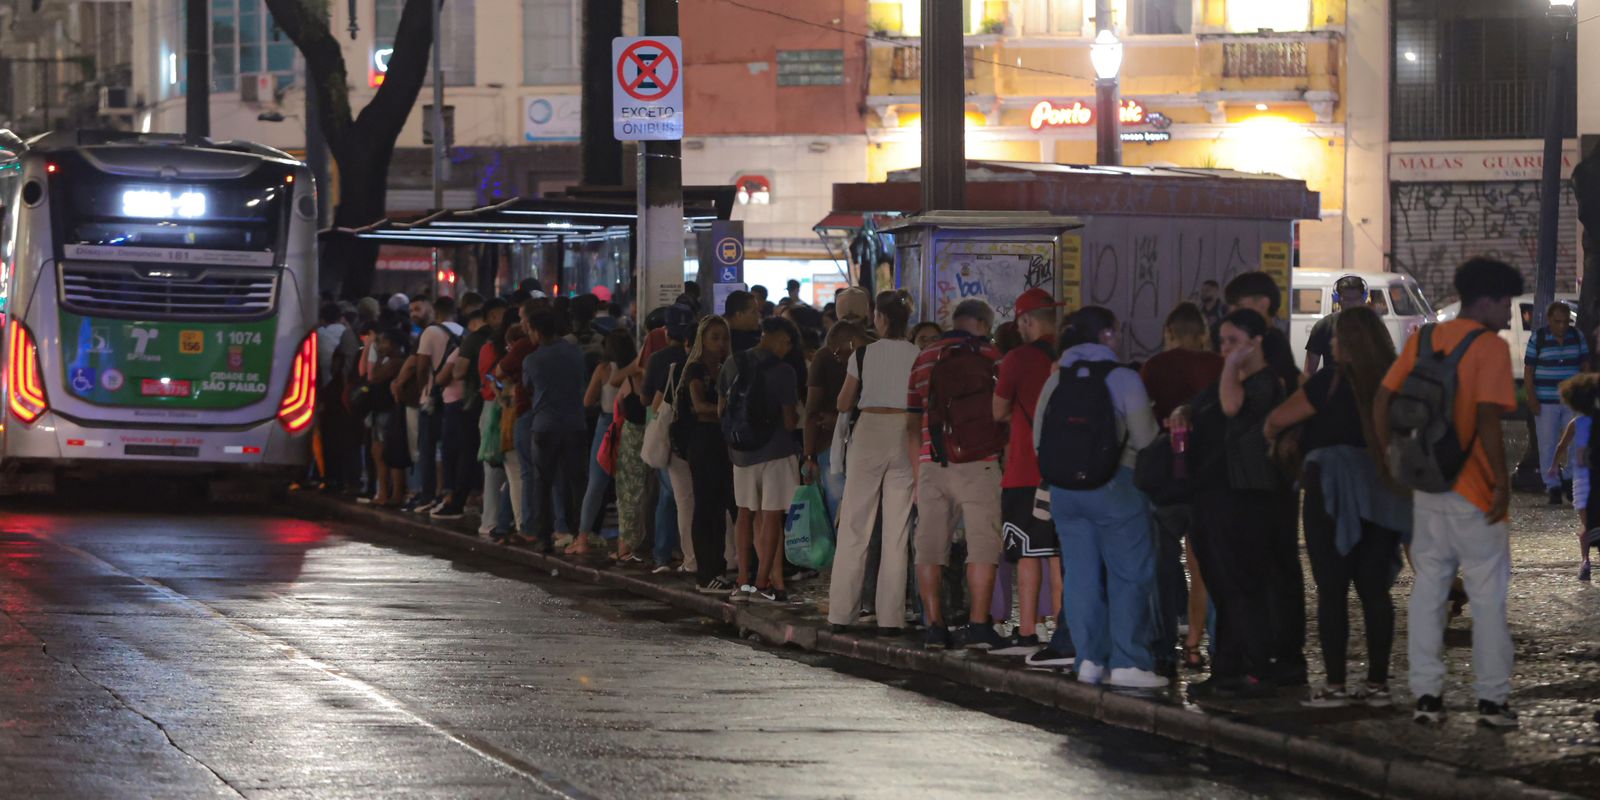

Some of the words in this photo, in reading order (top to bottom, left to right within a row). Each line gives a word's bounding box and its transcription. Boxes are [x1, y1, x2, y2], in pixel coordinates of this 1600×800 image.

[621, 106, 675, 118] EXCETO
[1031, 101, 1092, 129] Ponto
[623, 120, 674, 134] ÔNIBUS
[1399, 157, 1464, 169] MALAS
[167, 251, 190, 261] 181
[216, 330, 224, 345] 1
[229, 331, 263, 346] 1074
[182, 341, 201, 352] 156
[210, 371, 244, 381] CIDADE
[246, 373, 260, 382] DE
[228, 382, 267, 393] PAULO
